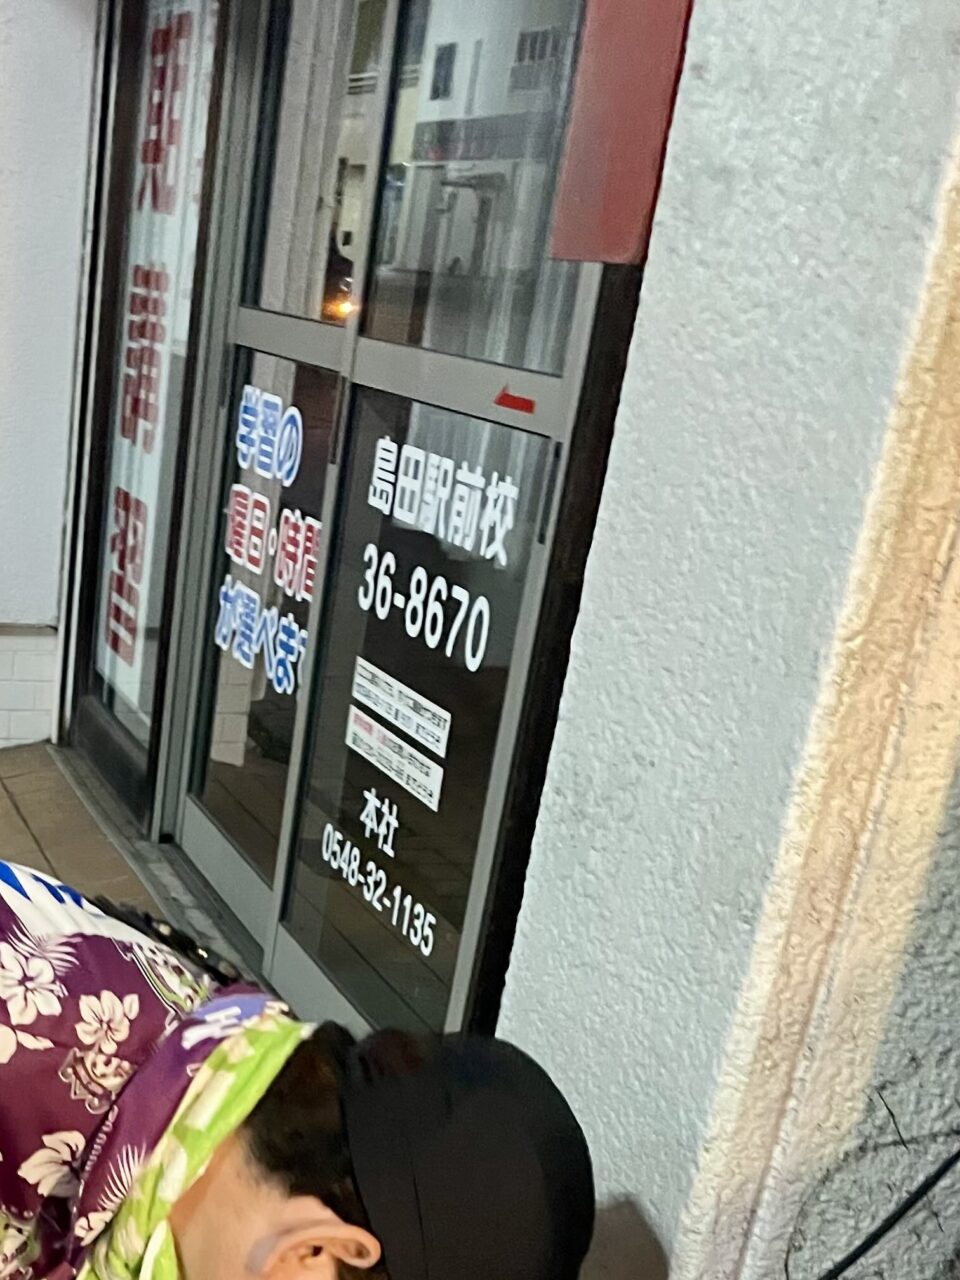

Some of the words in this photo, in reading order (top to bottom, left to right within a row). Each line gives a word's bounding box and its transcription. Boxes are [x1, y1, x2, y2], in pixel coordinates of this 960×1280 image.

[234, 384, 304, 488] 学習の
[367, 435, 521, 568] 島田駅前校
[356, 542, 492, 674] 36-8670
[359, 787, 400, 859] 本社
[320, 821, 437, 958] 0548-32-1135
